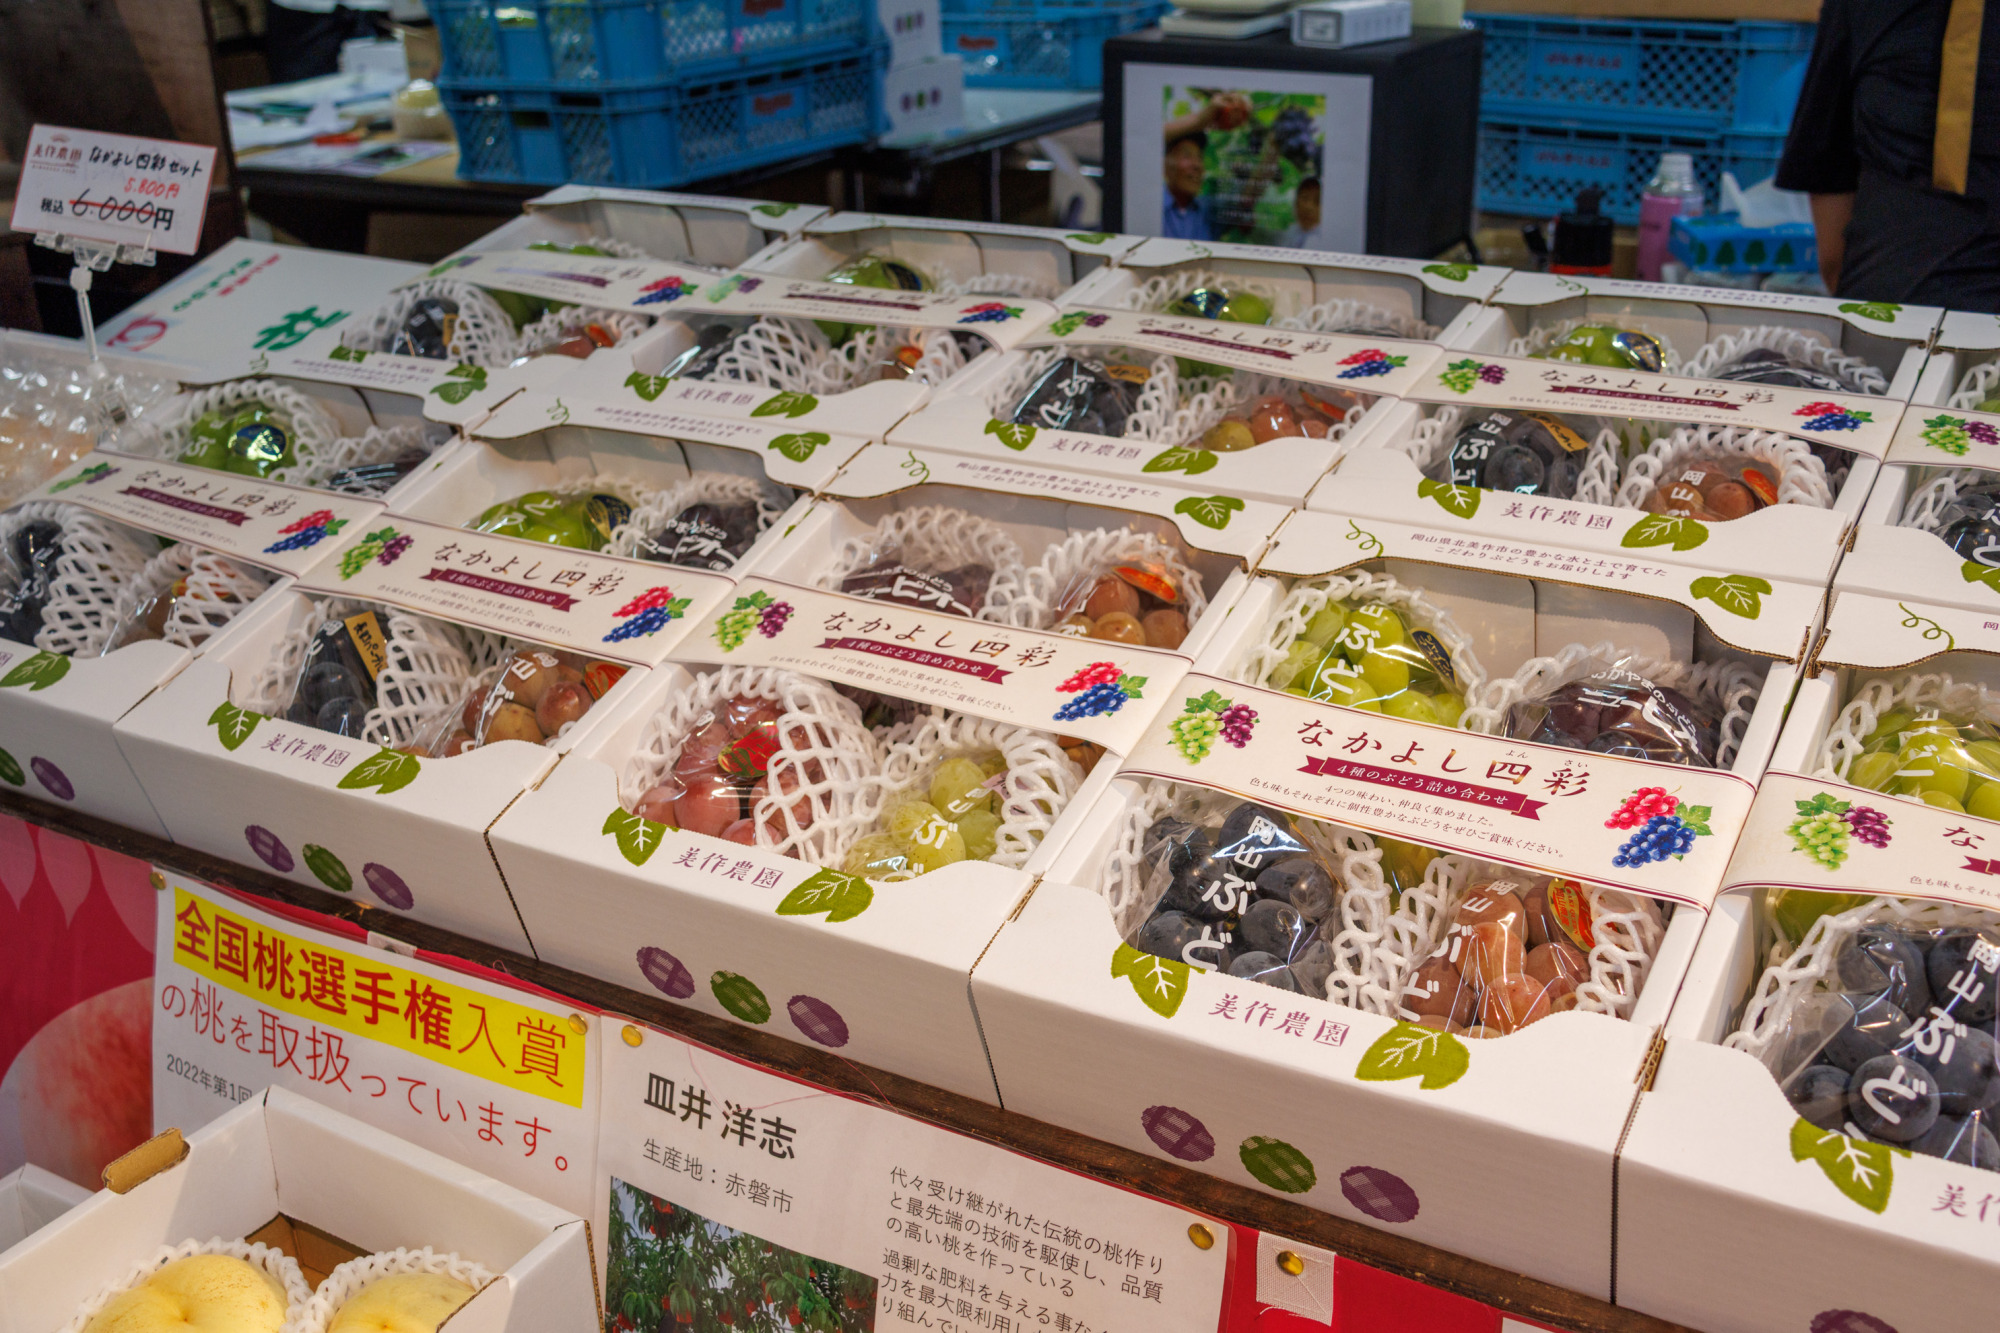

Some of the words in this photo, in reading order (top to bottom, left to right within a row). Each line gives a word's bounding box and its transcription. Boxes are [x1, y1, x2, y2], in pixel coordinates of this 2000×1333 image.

[41, 198, 63, 214] 税込
[1540, 369, 1775, 404] なかよし四彩
[1048, 438, 1142, 459] 美作農園
[1502, 502, 1613, 529] 美作農園
[435, 543, 625, 596] なかよし四彩
[1411, 533, 1668, 577] 岡山県北美作市の豊かな水と土で育てた
[1435, 547, 1633, 580] こだわりぶどうをお届けします
[824, 611, 1057, 668] なかよし四彩
[847, 640, 982, 674] 4種のぶどう詰め合わせ
[261, 733, 350, 767] 美作農園
[1297, 719, 1590, 797] なかよし四彩
[1505, 749, 1529, 759] よん
[1564, 759, 1588, 768] さい
[1324, 785, 1494, 828] 4つの味わい、仲良く集めました。
[1336, 763, 1510, 806] 4種のぶどう詰め合わせ
[1249, 776, 1565, 859] 色も味もそれぞれに個性豊かなぶどうをぜひご賞味ください。
[672, 846, 784, 889] 美作農園
[176, 899, 566, 1088] 全国桃選手権入賞
[1209, 993, 1351, 1047] 美作農園
[161, 977, 569, 1172] の桃を取扱っています。
[644, 1072, 711, 1130] 皿井
[720, 1100, 797, 1160] 洋志
[643, 1138, 794, 1214] 生産地：赤磐市
[890, 1165, 1163, 1276] 代々受け継がれた伝統の桃作り
[886, 1216, 1075, 1298] の高い桃を作っている
[890, 1192, 1164, 1304] と最先端の技術を駆使し、品質
[881, 1273, 1044, 1333] 力を最大限利用し
